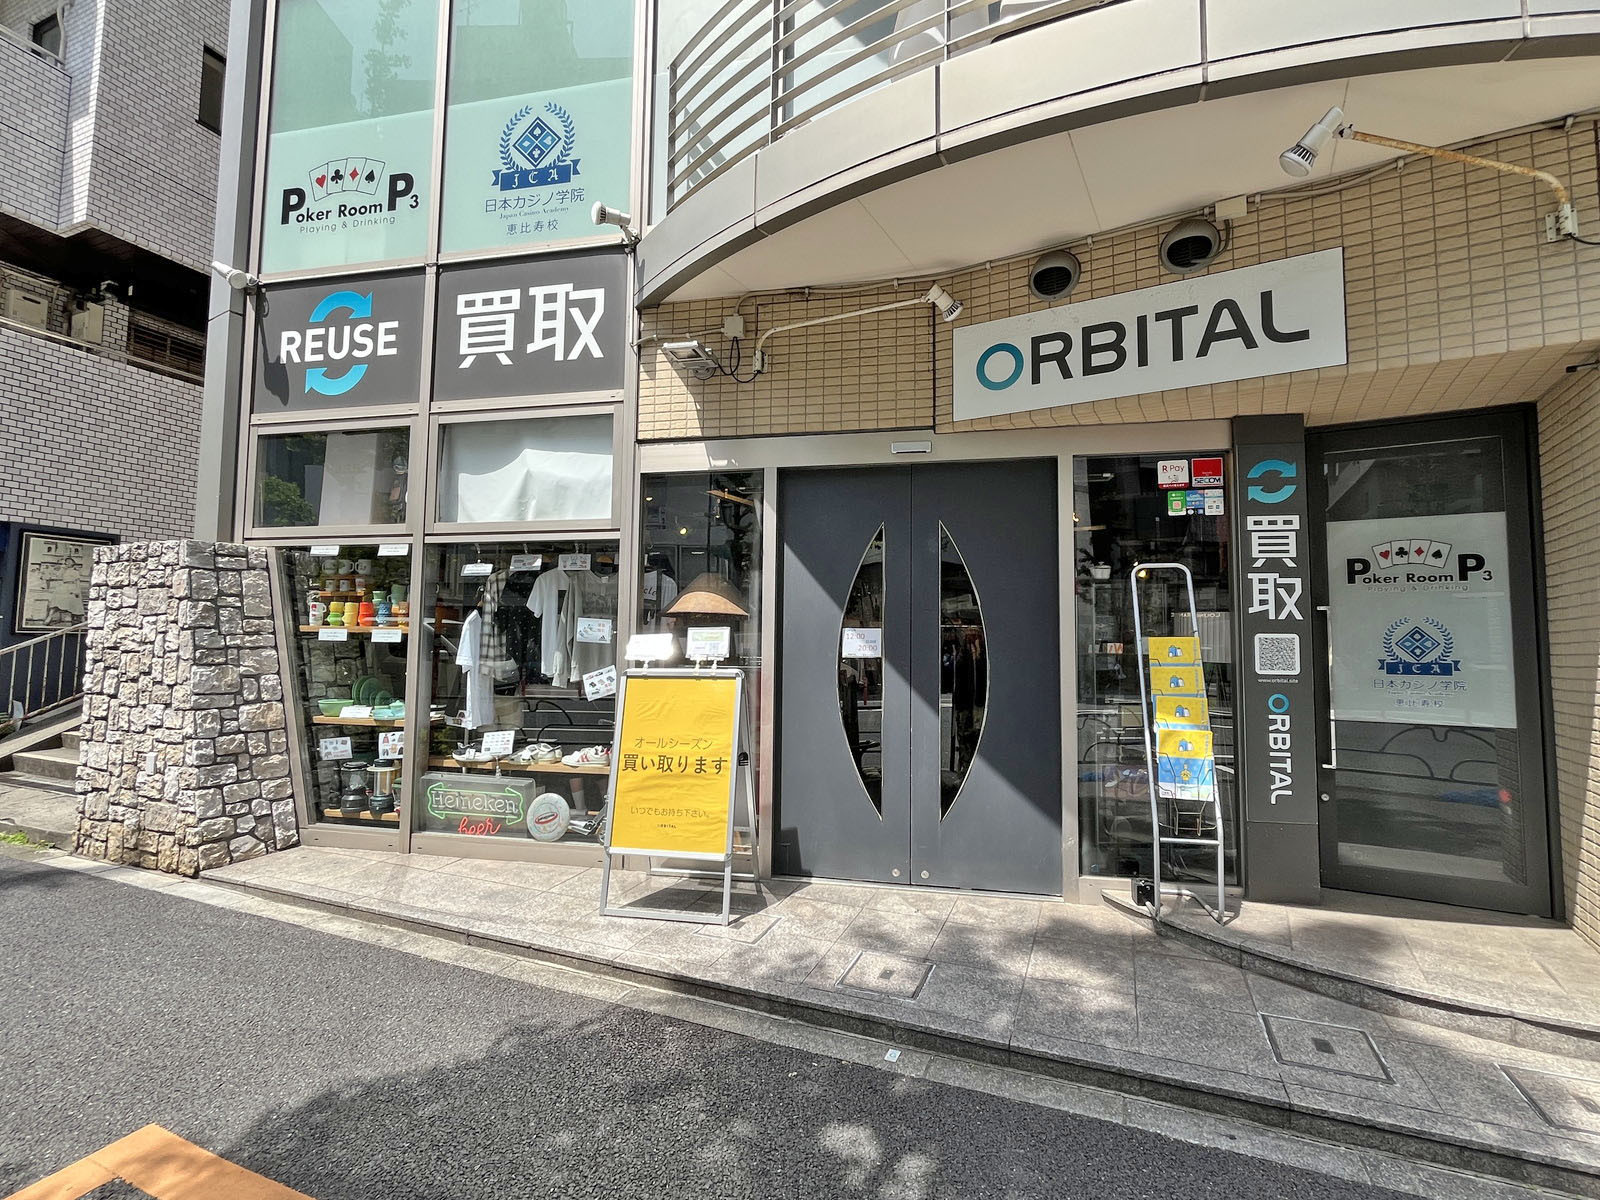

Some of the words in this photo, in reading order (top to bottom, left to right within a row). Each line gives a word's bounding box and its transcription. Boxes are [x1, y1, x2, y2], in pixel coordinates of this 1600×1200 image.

[281, 188, 333, 225] Poker
[338, 203, 383, 218] Room
[485, 188, 585, 213] 日本カジノ学院
[543, 206, 570, 214] Academy
[300, 223, 337, 234] Playing
[341, 221, 348, 229] &
[353, 216, 396, 228] Drinking
[506, 219, 559, 236] 恵比寿校
[456, 283, 606, 369] 買取
[280, 320, 399, 364] REUSE
[975, 290, 1310, 391] ORBITAL
[1169, 464, 1185, 473] Pay
[1247, 515, 1304, 620] 買取
[1346, 558, 1399, 584] Poker
[1406, 573, 1454, 583] Room
[634, 737, 714, 751] オールシーズン
[1266, 693, 1293, 805] ORBITAL
[622, 753, 728, 775] 買い取ります
[431, 790, 519, 814] Heineken
